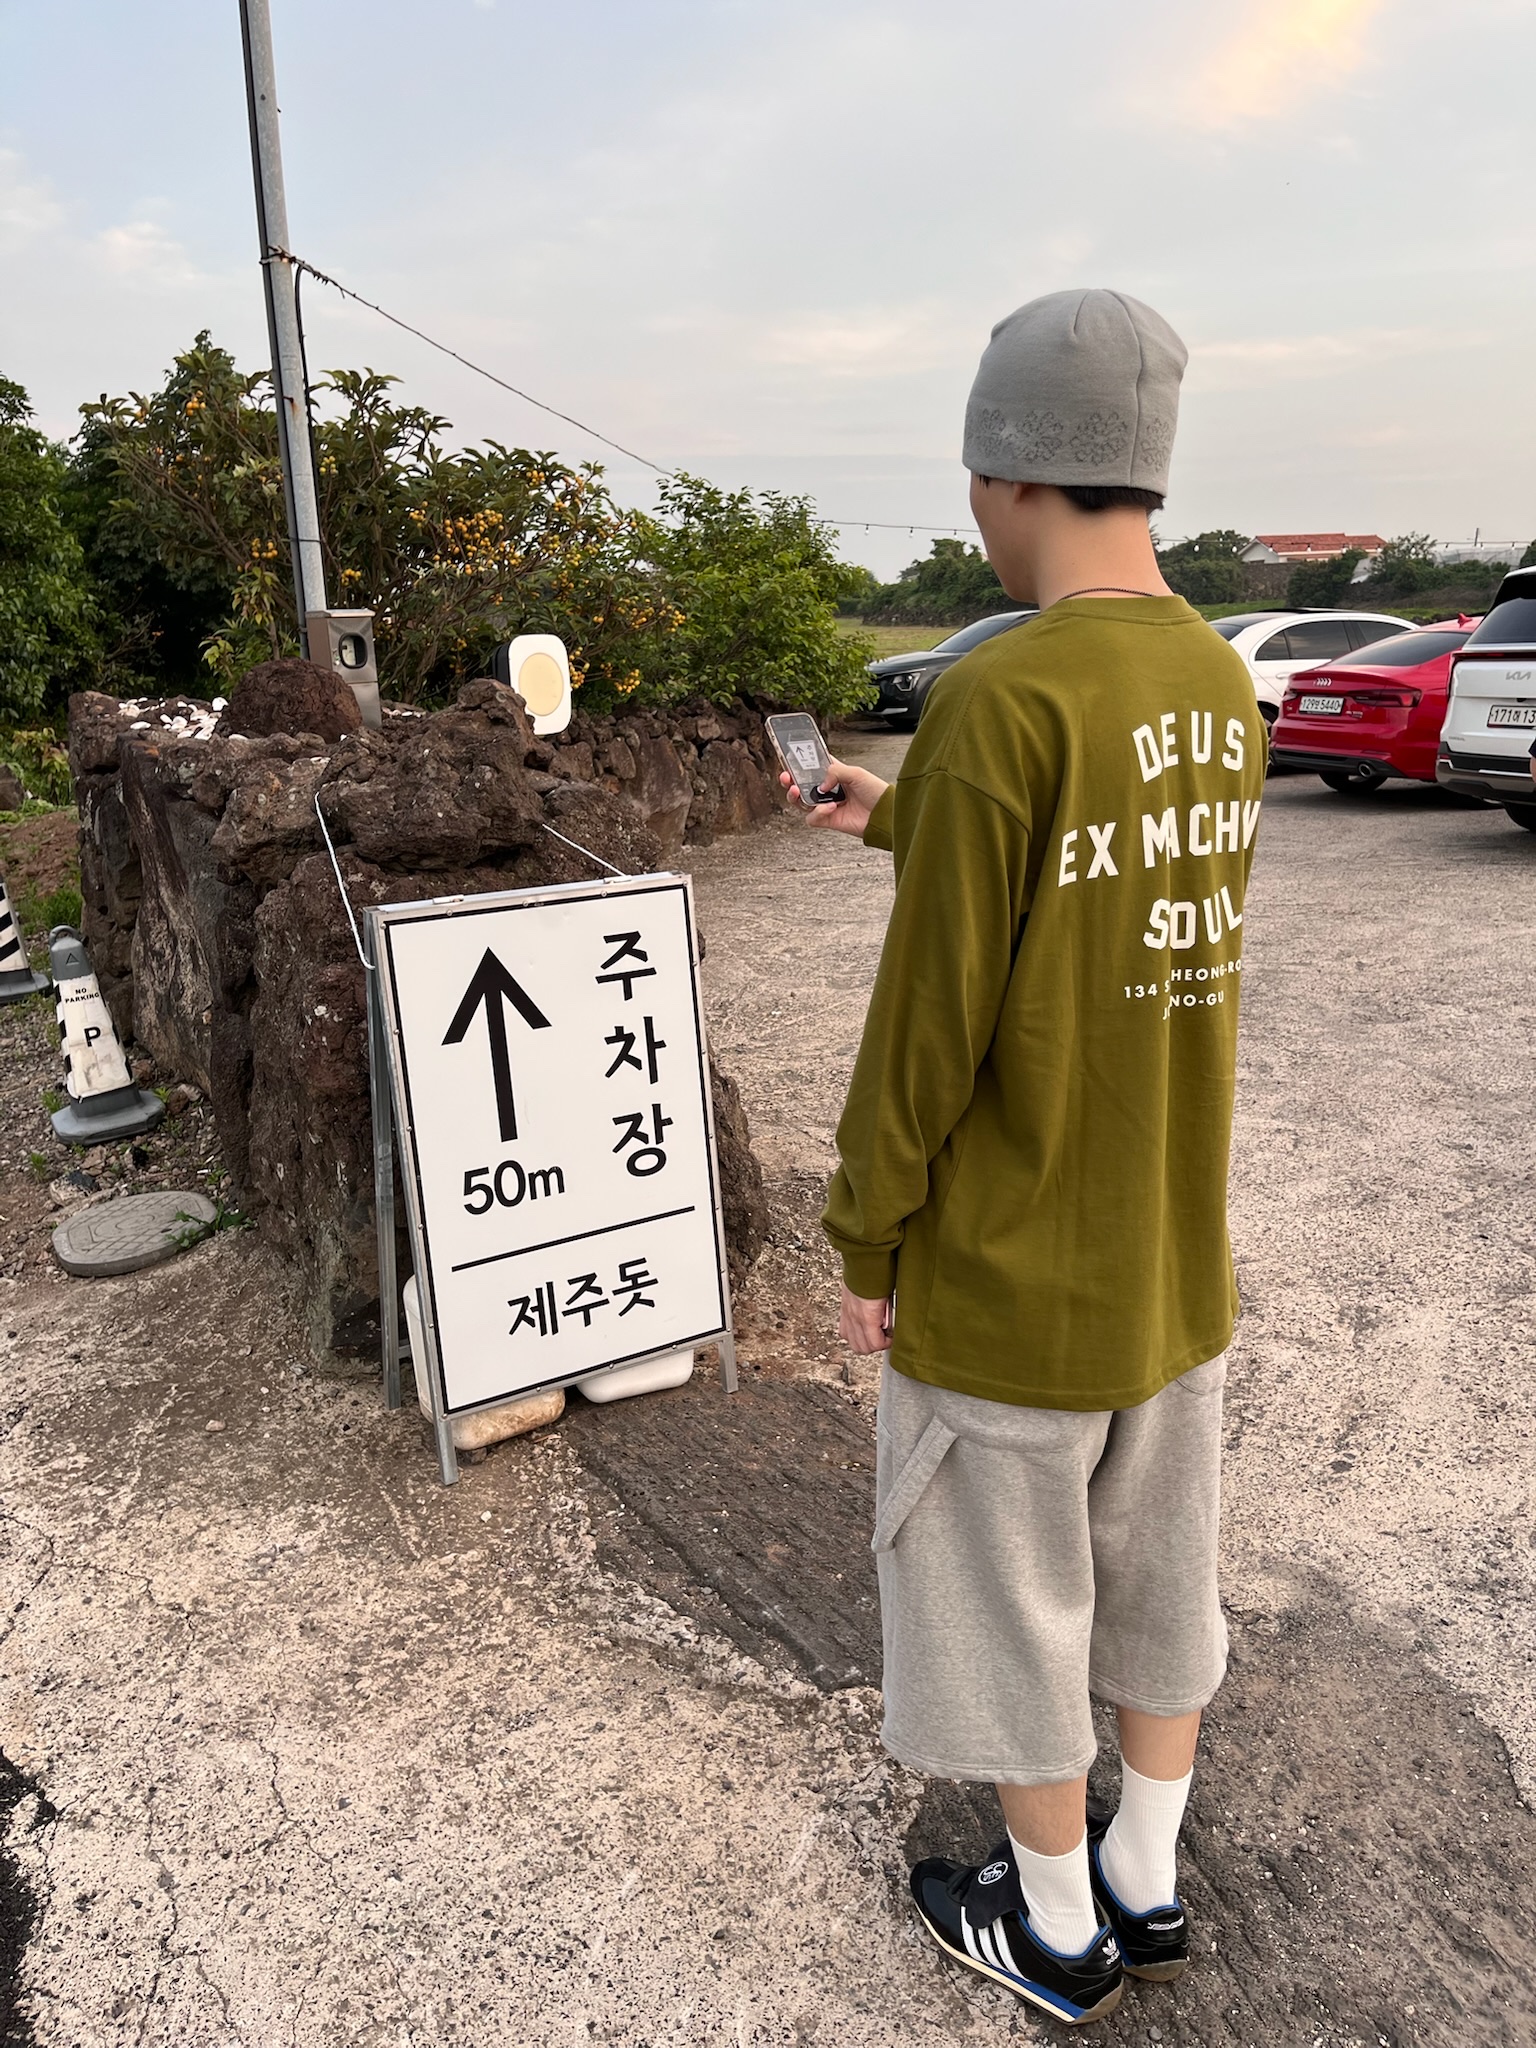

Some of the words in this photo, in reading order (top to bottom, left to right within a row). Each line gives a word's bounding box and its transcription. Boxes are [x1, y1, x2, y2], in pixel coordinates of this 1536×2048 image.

[1132, 711, 1245, 783] DEUS
[1058, 822, 1119, 887] EX
[65, 992, 100, 1004] PARKING
[75, 987, 87, 995] NO
[1124, 983, 1158, 999] 134
[84, 1026, 101, 1047] P
[595, 930, 674, 1177] 주차장
[463, 1160, 565, 1215] 50m
[507, 1257, 659, 1337] 제주돗
